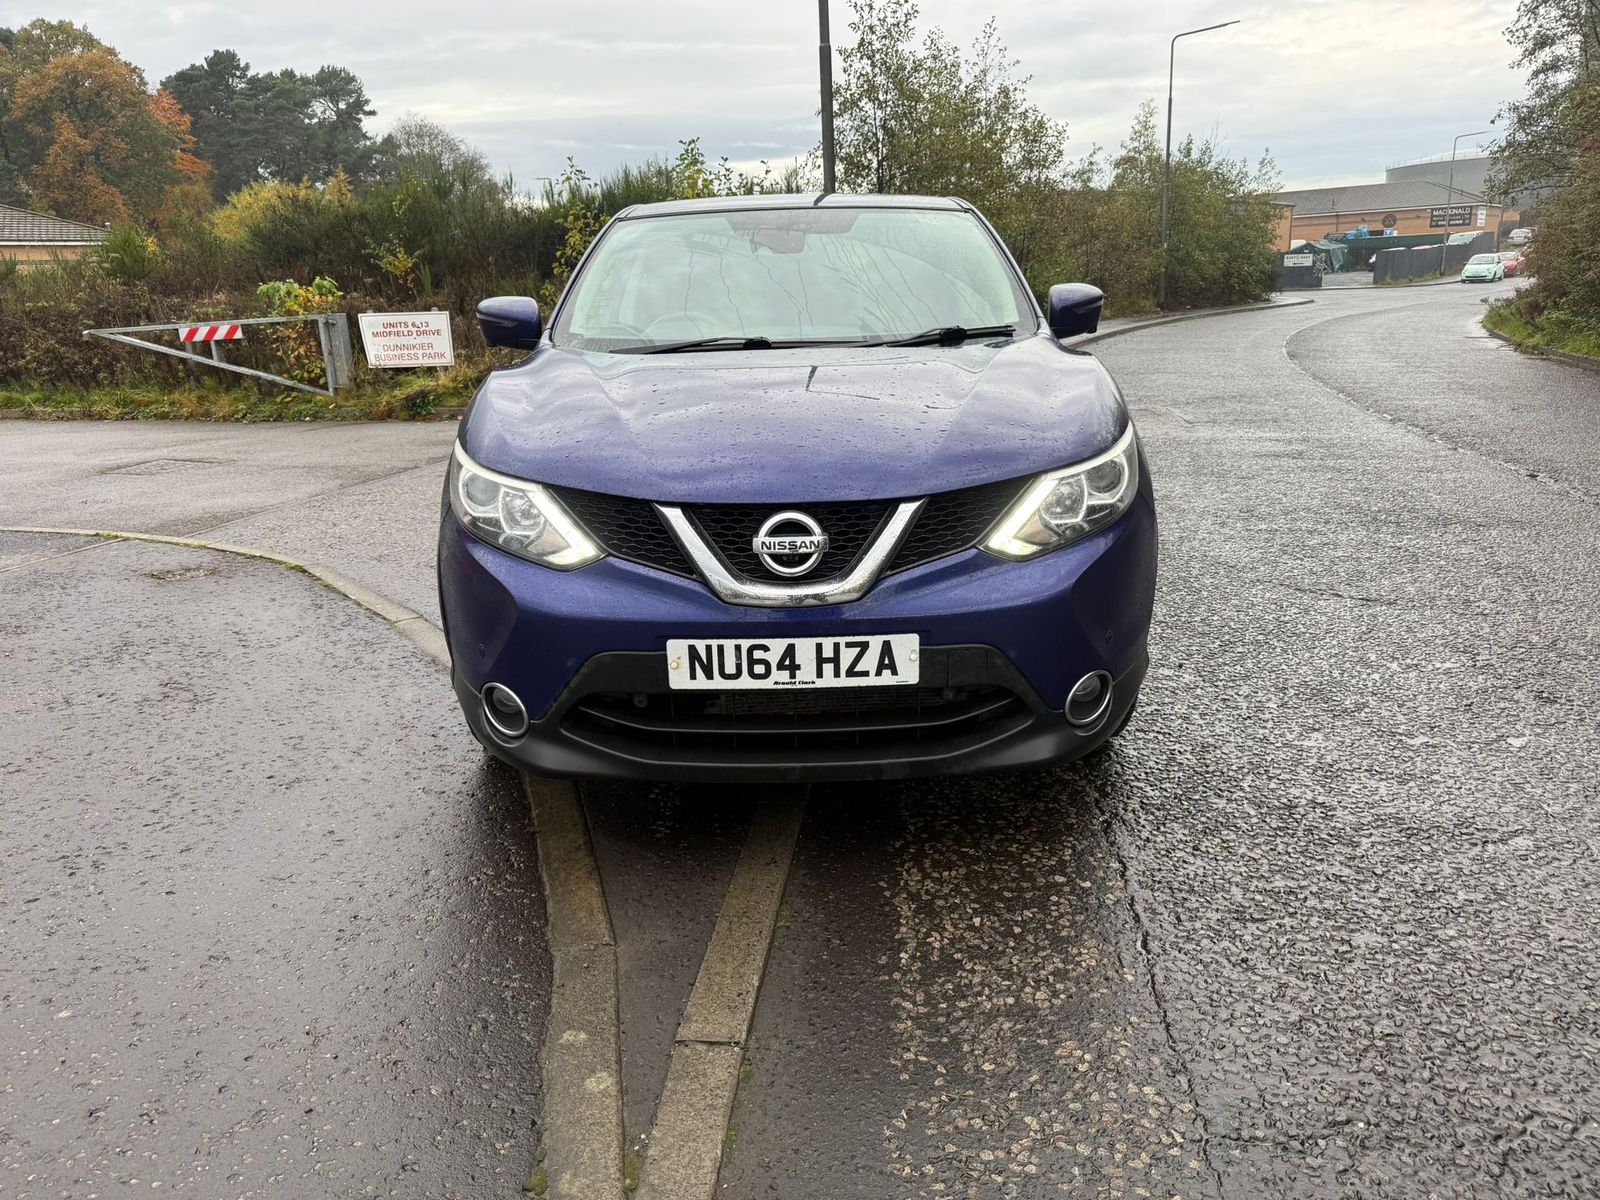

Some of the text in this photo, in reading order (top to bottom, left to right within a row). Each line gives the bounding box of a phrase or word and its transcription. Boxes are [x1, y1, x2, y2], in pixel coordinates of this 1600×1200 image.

[382, 321, 409, 330] UNITS
[372, 329, 442, 338] MIDFIELD DRIVE
[382, 342, 434, 352] DUNNIKIER
[374, 352, 446, 362] BUSINESS PARK
[760, 540, 820, 551] NISSAN
[687, 639, 899, 681] NU64 HZA
